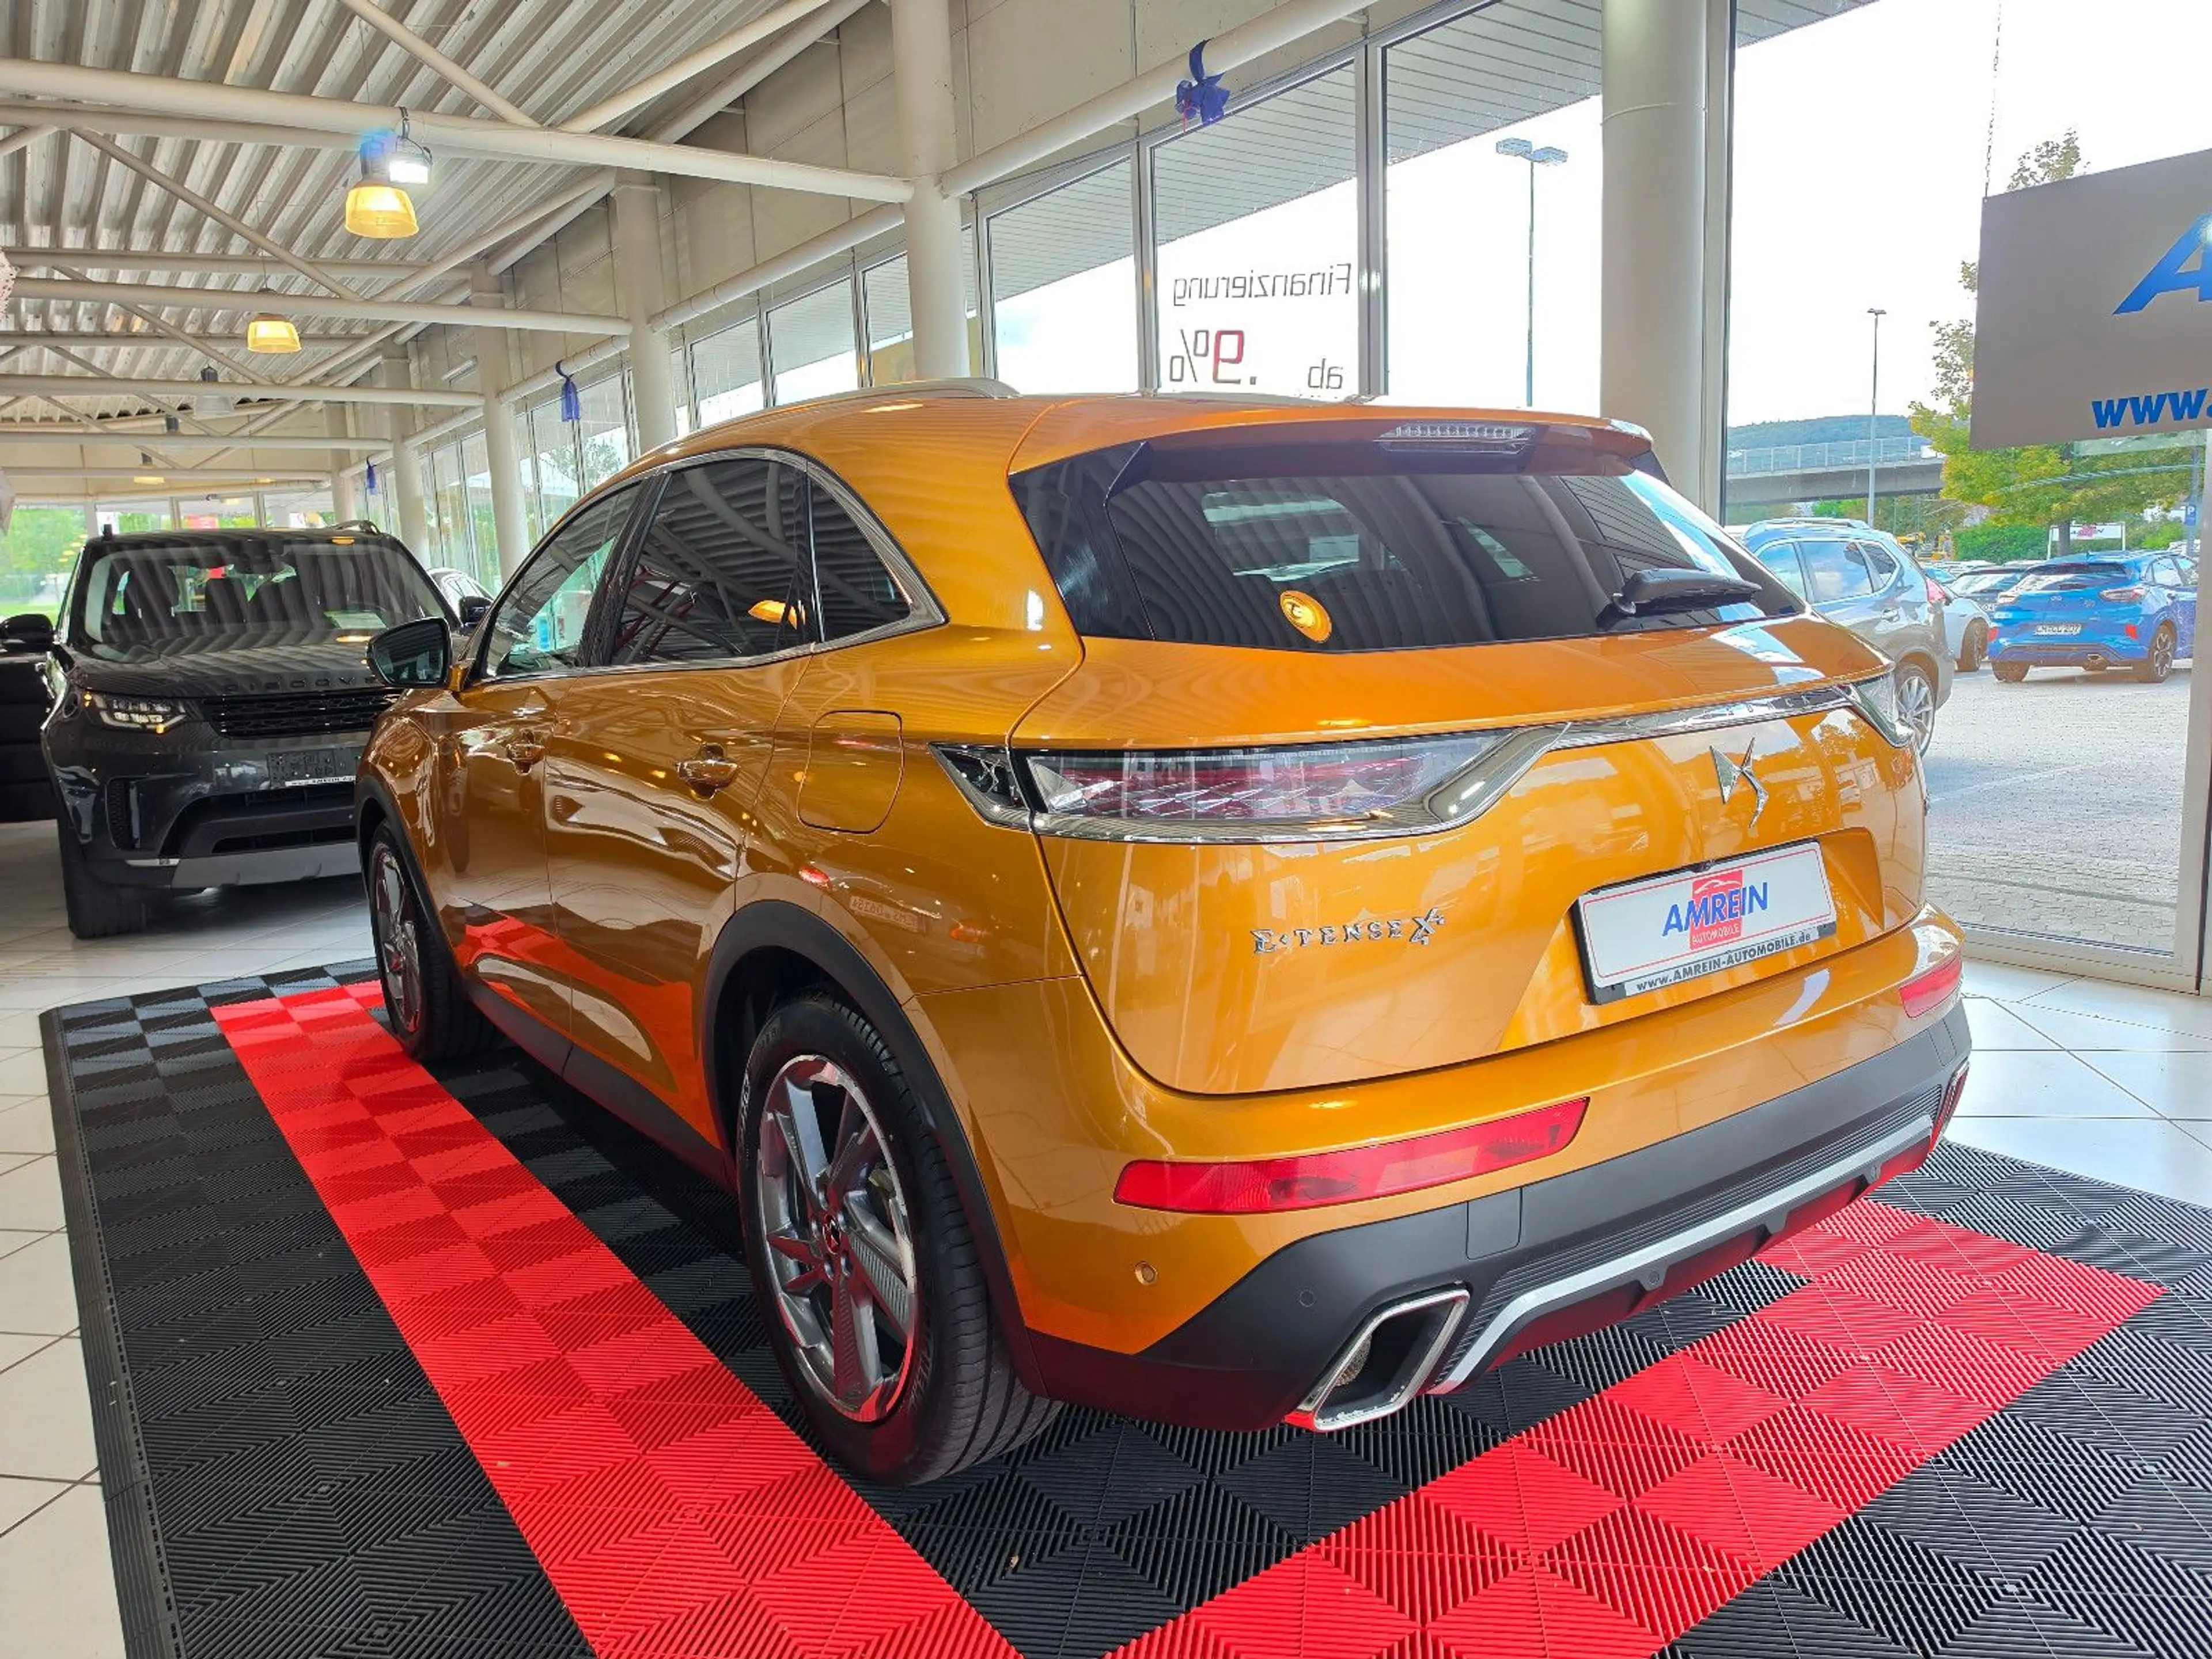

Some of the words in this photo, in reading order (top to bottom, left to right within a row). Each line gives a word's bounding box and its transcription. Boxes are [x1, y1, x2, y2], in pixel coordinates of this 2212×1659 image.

[1662, 882, 1768, 937] AMREIN
[1692, 923, 1740, 945] AUTOMOBILE
[1637, 931, 1811, 991] www.AMREIN-AUTOMOBILE.de
